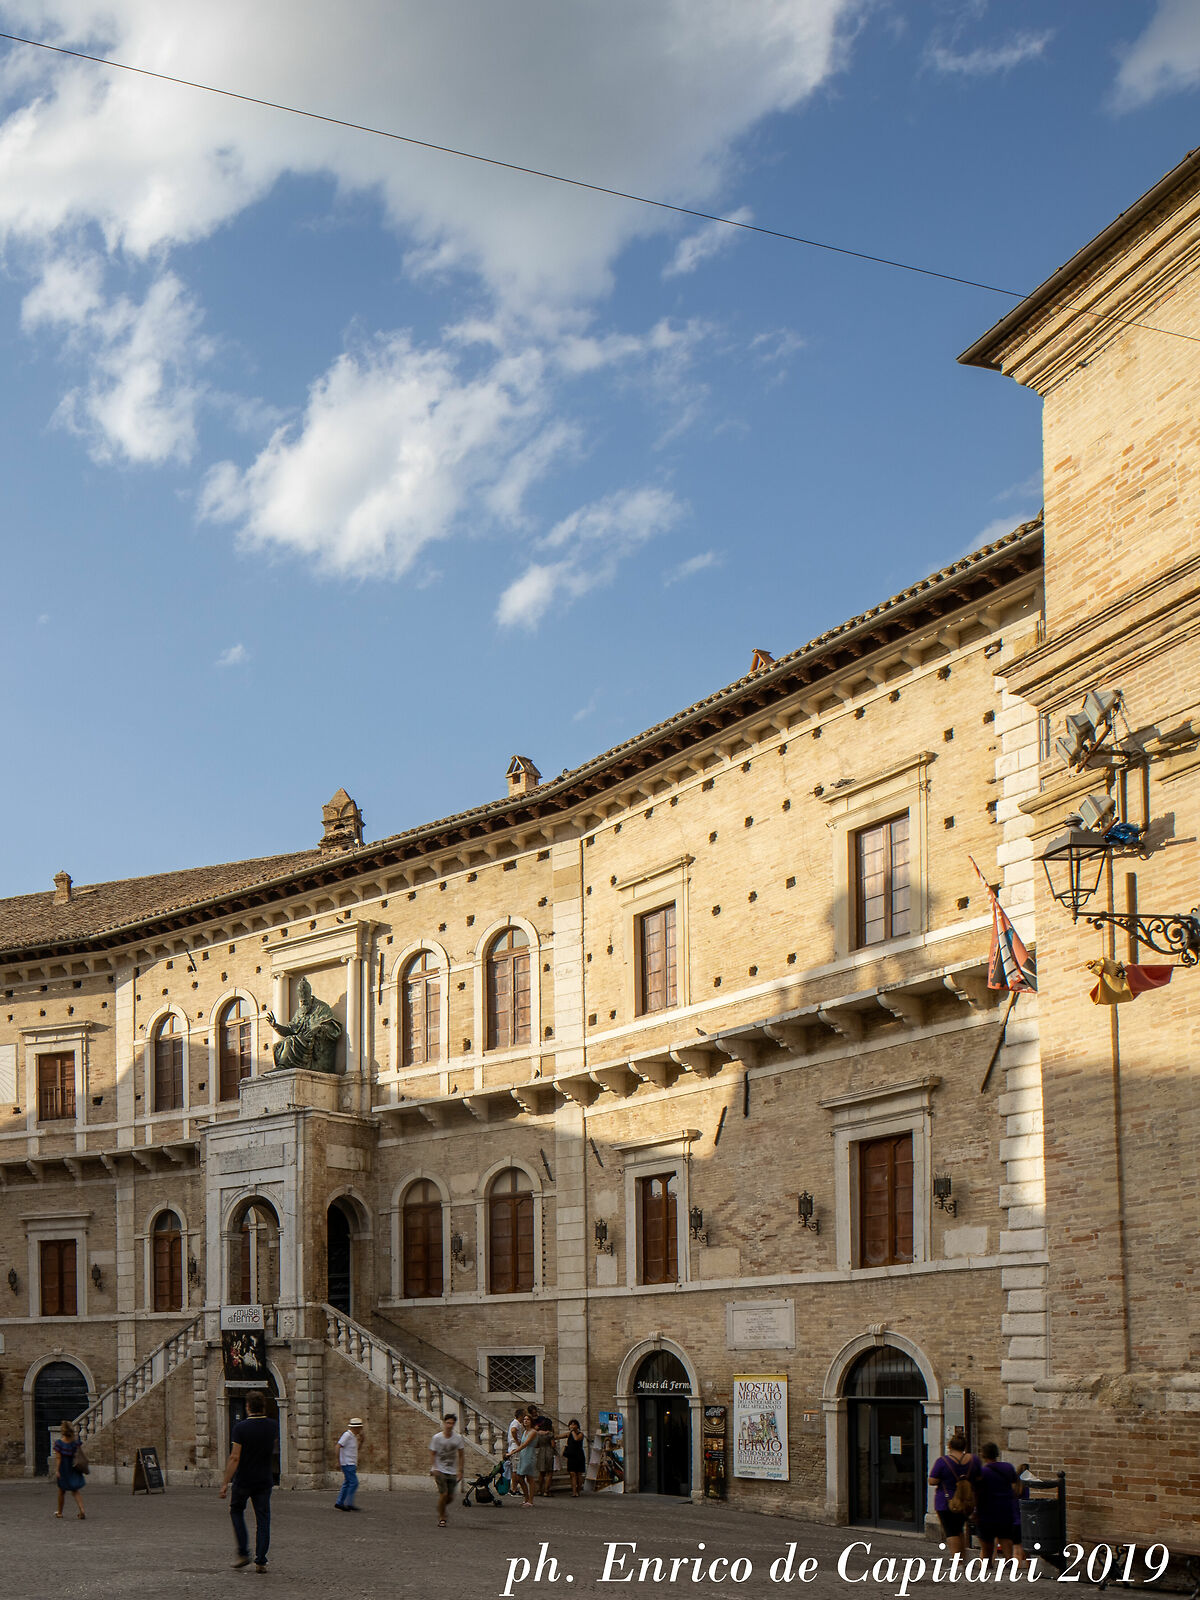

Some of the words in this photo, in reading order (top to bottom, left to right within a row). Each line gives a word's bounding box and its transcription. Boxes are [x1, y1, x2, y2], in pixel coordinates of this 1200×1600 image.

[637, 1381, 659, 1389] Musei
[660, 1380, 669, 1389] di
[739, 1382, 780, 1392] MOSTRA
[738, 1391, 782, 1401] MERCATO
[738, 1438, 782, 1452] FERMO
